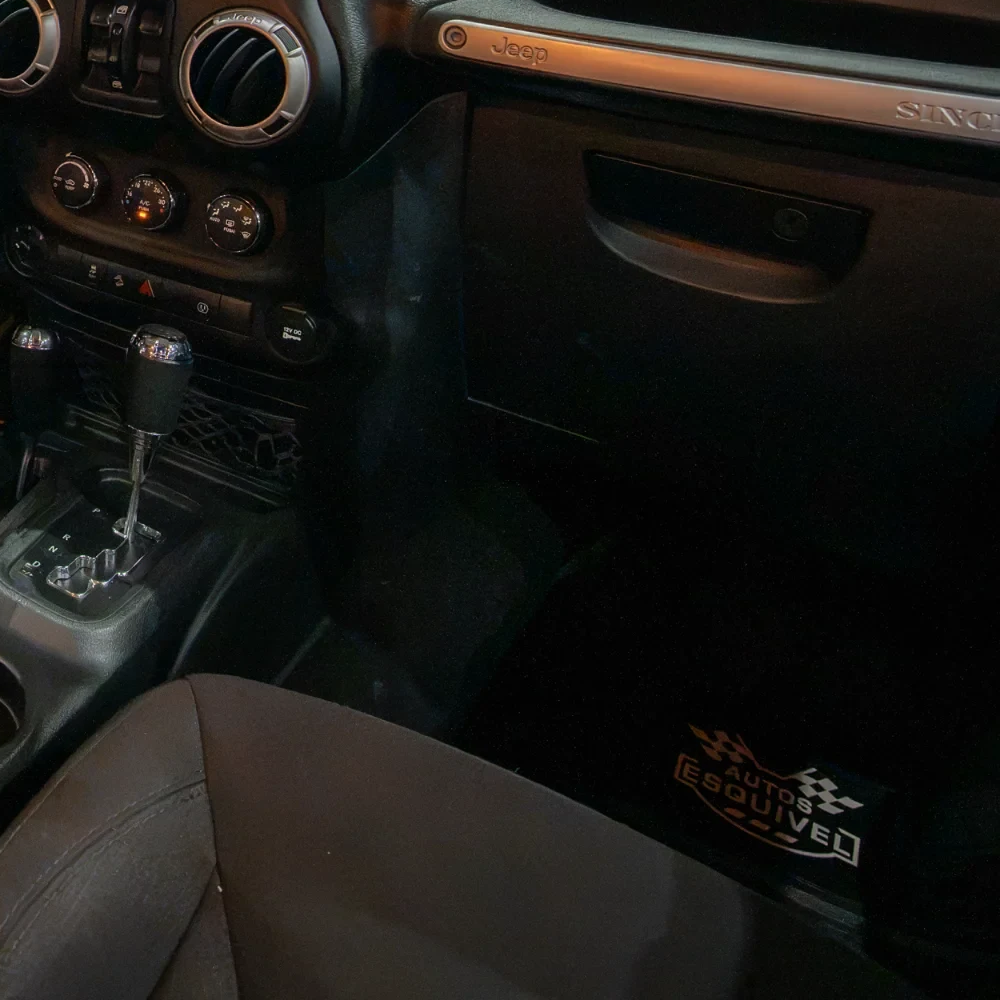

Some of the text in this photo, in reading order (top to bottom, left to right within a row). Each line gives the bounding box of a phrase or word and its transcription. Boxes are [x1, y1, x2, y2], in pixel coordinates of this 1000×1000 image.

[227, 13, 262, 25] Jeep
[491, 36, 548, 65] Jeep
[48, 545, 59, 553] N
[32, 560, 41, 568] D
[724, 765, 813, 815] AUTOS
[681, 761, 851, 858] ESQUIVEL
